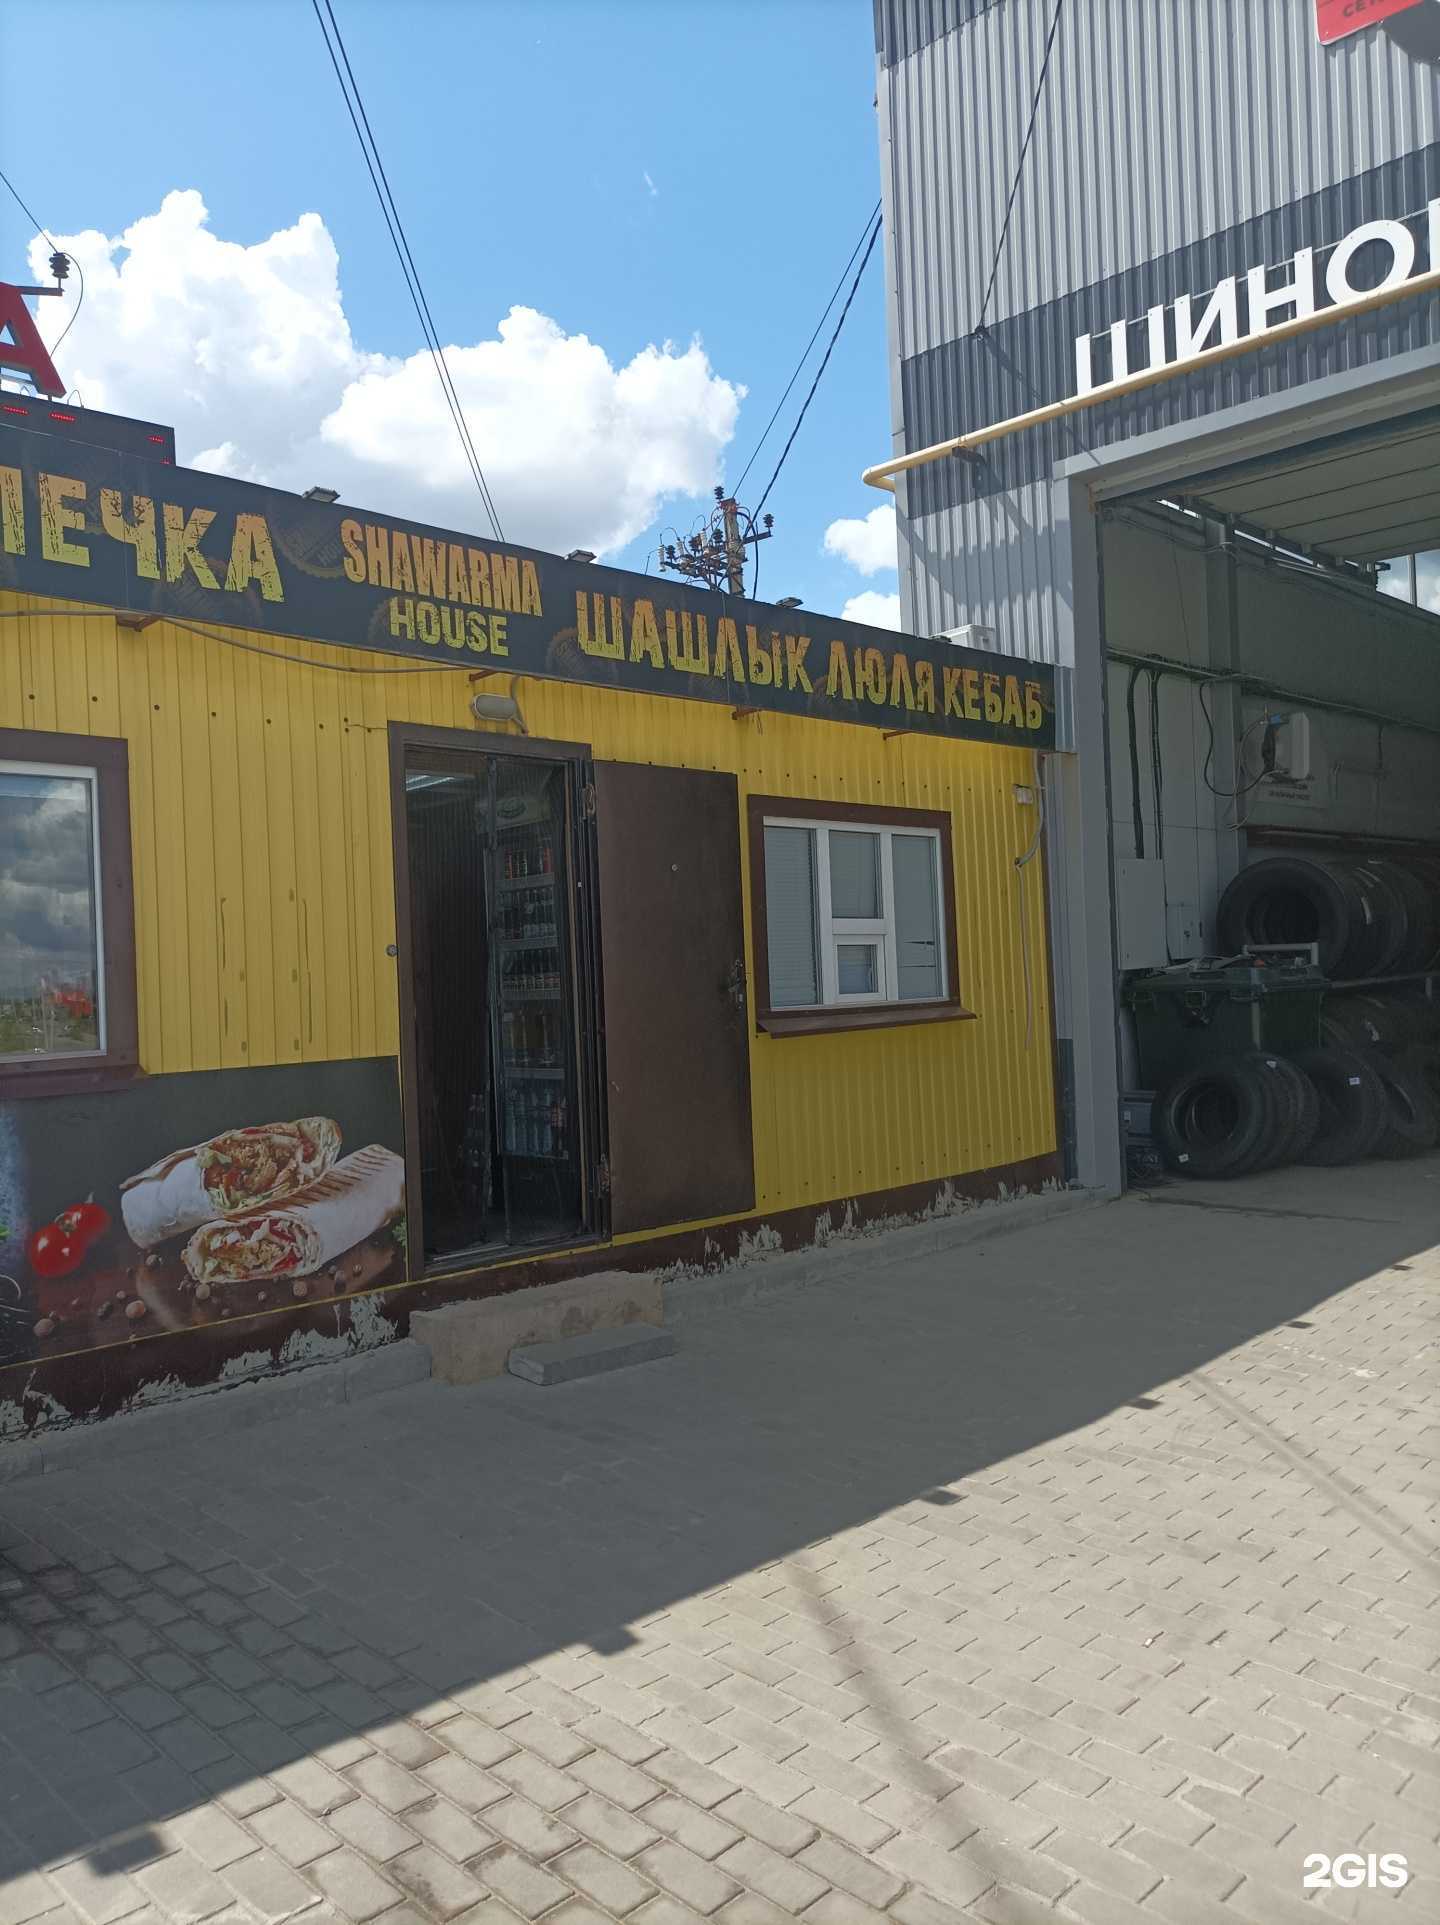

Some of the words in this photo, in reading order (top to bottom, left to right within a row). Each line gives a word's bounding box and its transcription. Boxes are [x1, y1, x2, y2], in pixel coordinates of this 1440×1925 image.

[1075, 196, 1440, 396] ШИНО
[340, 519, 543, 617] SHAWARMA
[388, 597, 510, 657] HOUSE
[575, 590, 814, 694] ШАШЛЫК
[826, 640, 936, 714] ЛЮЛЯ
[943, 665, 1042, 730] КЕБАБ
